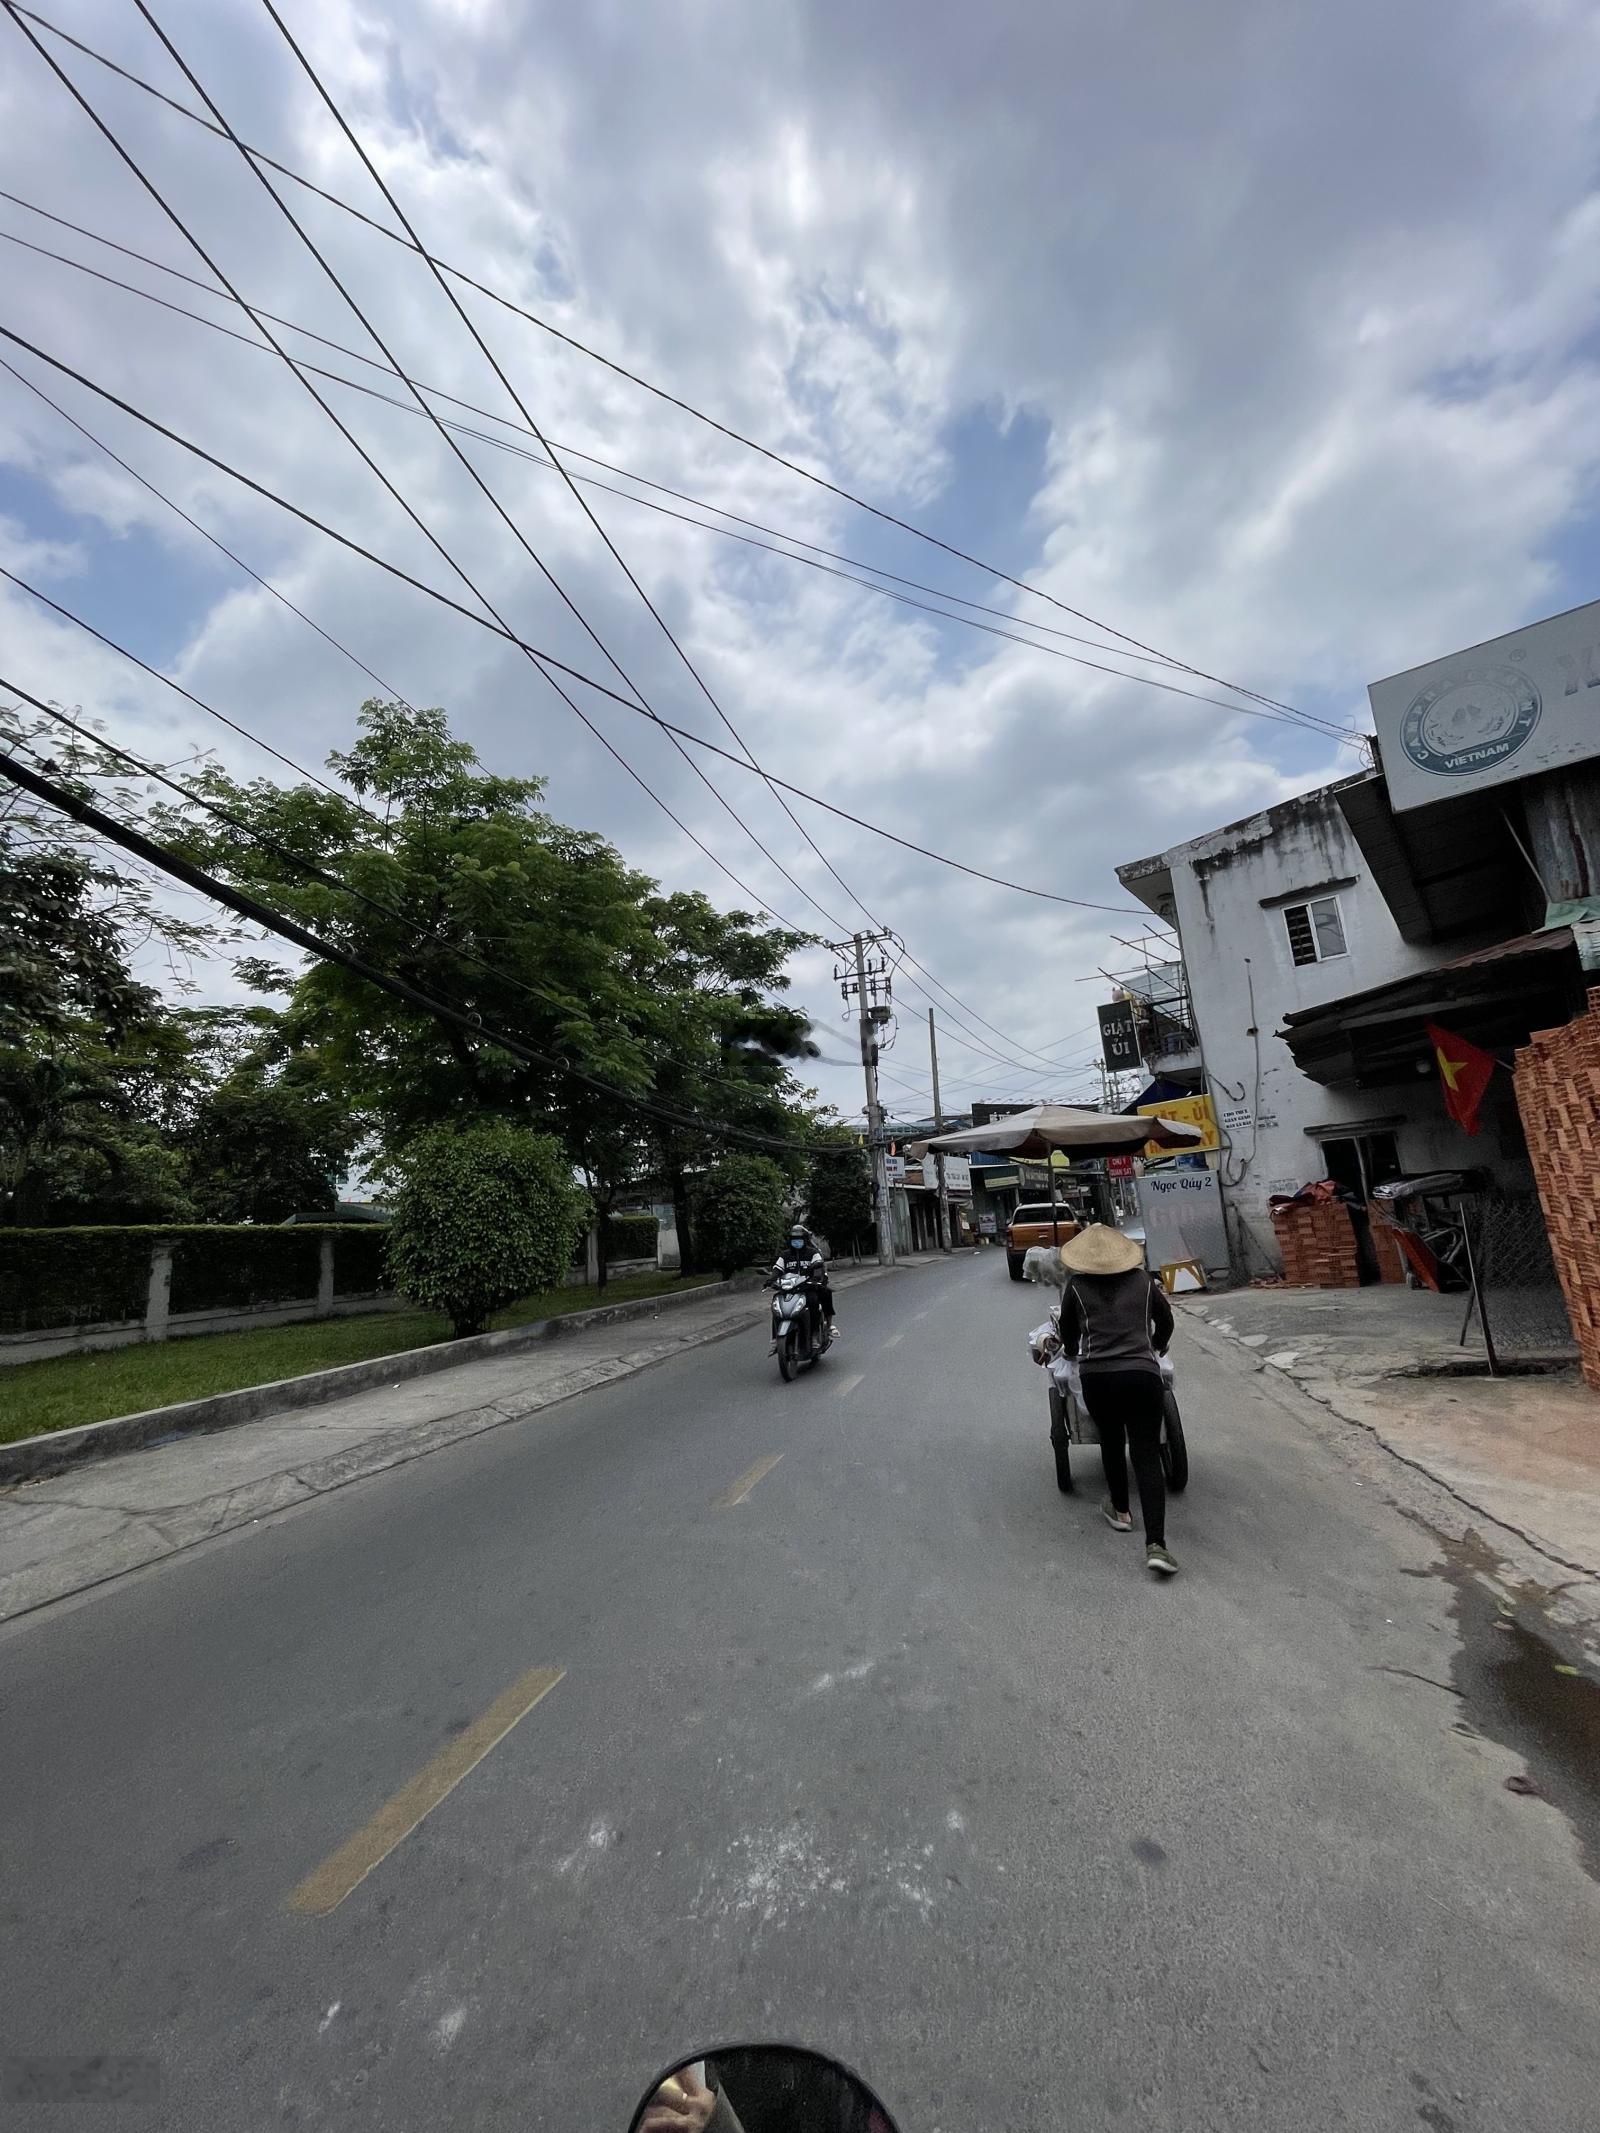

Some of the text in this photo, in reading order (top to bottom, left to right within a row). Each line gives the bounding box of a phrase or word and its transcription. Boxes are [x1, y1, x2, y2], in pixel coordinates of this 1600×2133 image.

[1444, 742, 1510, 769] VIETNAM
[1151, 1180, 1177, 1194] Ngọc
[1204, 1176, 1212, 1187] 2
